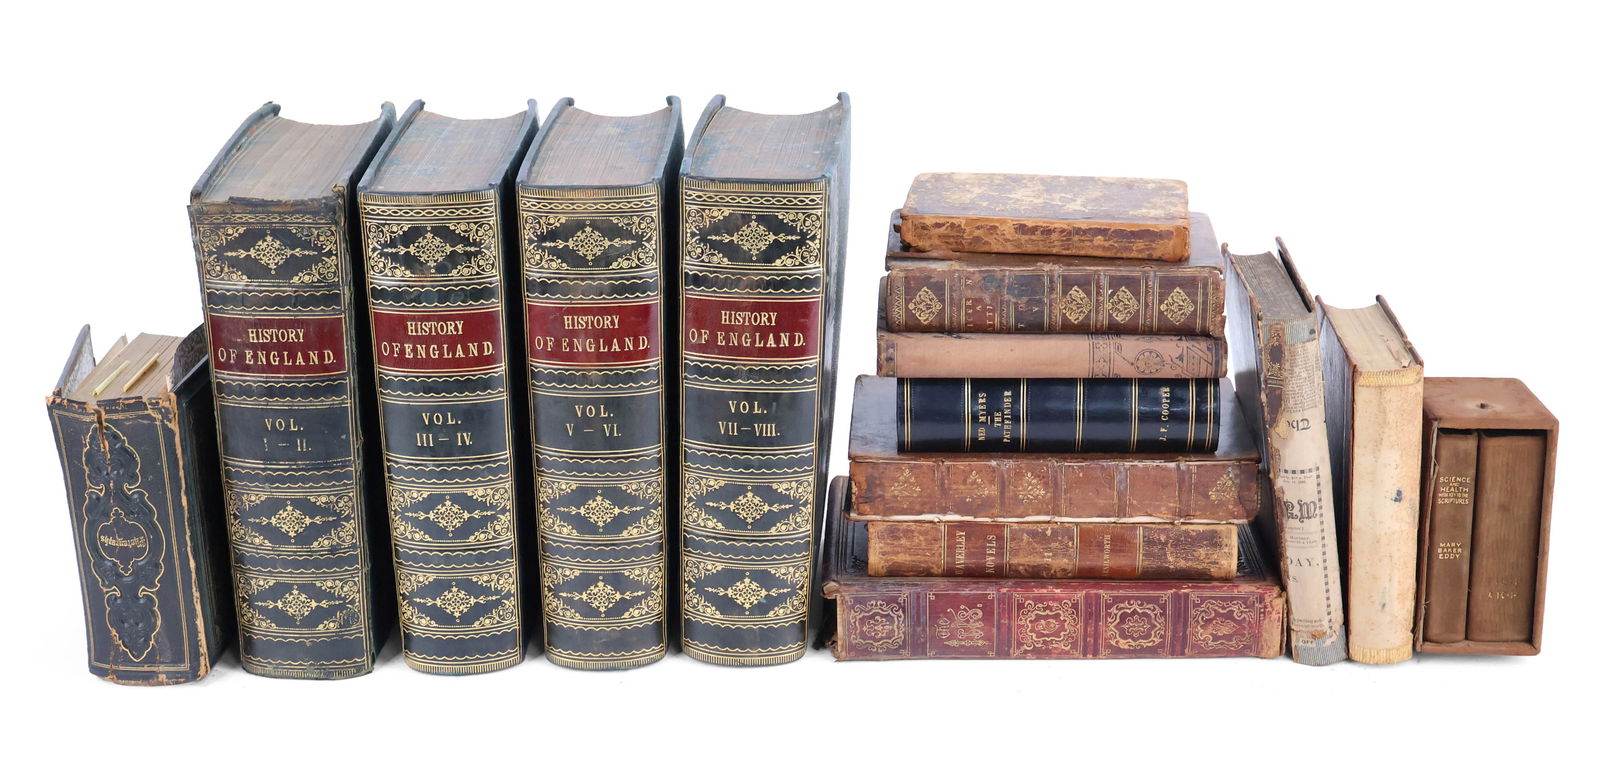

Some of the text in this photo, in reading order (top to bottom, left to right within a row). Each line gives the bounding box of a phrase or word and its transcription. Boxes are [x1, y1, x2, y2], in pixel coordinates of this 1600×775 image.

[563, 315, 620, 329] HISTORY
[720, 310, 778, 326] HISTORY
[248, 328, 304, 343] HISTORY
[407, 321, 464, 335] HISTORY
[535, 335, 650, 352] OF ENGLAND.
[689, 328, 806, 347] OF ENGLAND.
[218, 347, 336, 366] OF ENGLAND.
[381, 341, 495, 358] OF ENGLAND.
[575, 405, 613, 418] VOL.
[728, 400, 767, 414] VOL.
[1160, 387, 1170, 421] COOPER
[265, 418, 304, 431] VOL.
[422, 412, 461, 425] VOL.
[978, 392, 987, 441] NED MYERS
[994, 411, 1002, 427] THE
[1003, 390, 1012, 443] PATHFINDER
[566, 424, 574, 437] V
[603, 424, 622, 437] VI.
[457, 432, 473, 446] IV.
[955, 530, 966, 575] WAVERLEY
[986, 534, 997, 573] NOVELS
[934, 617, 951, 639] The
